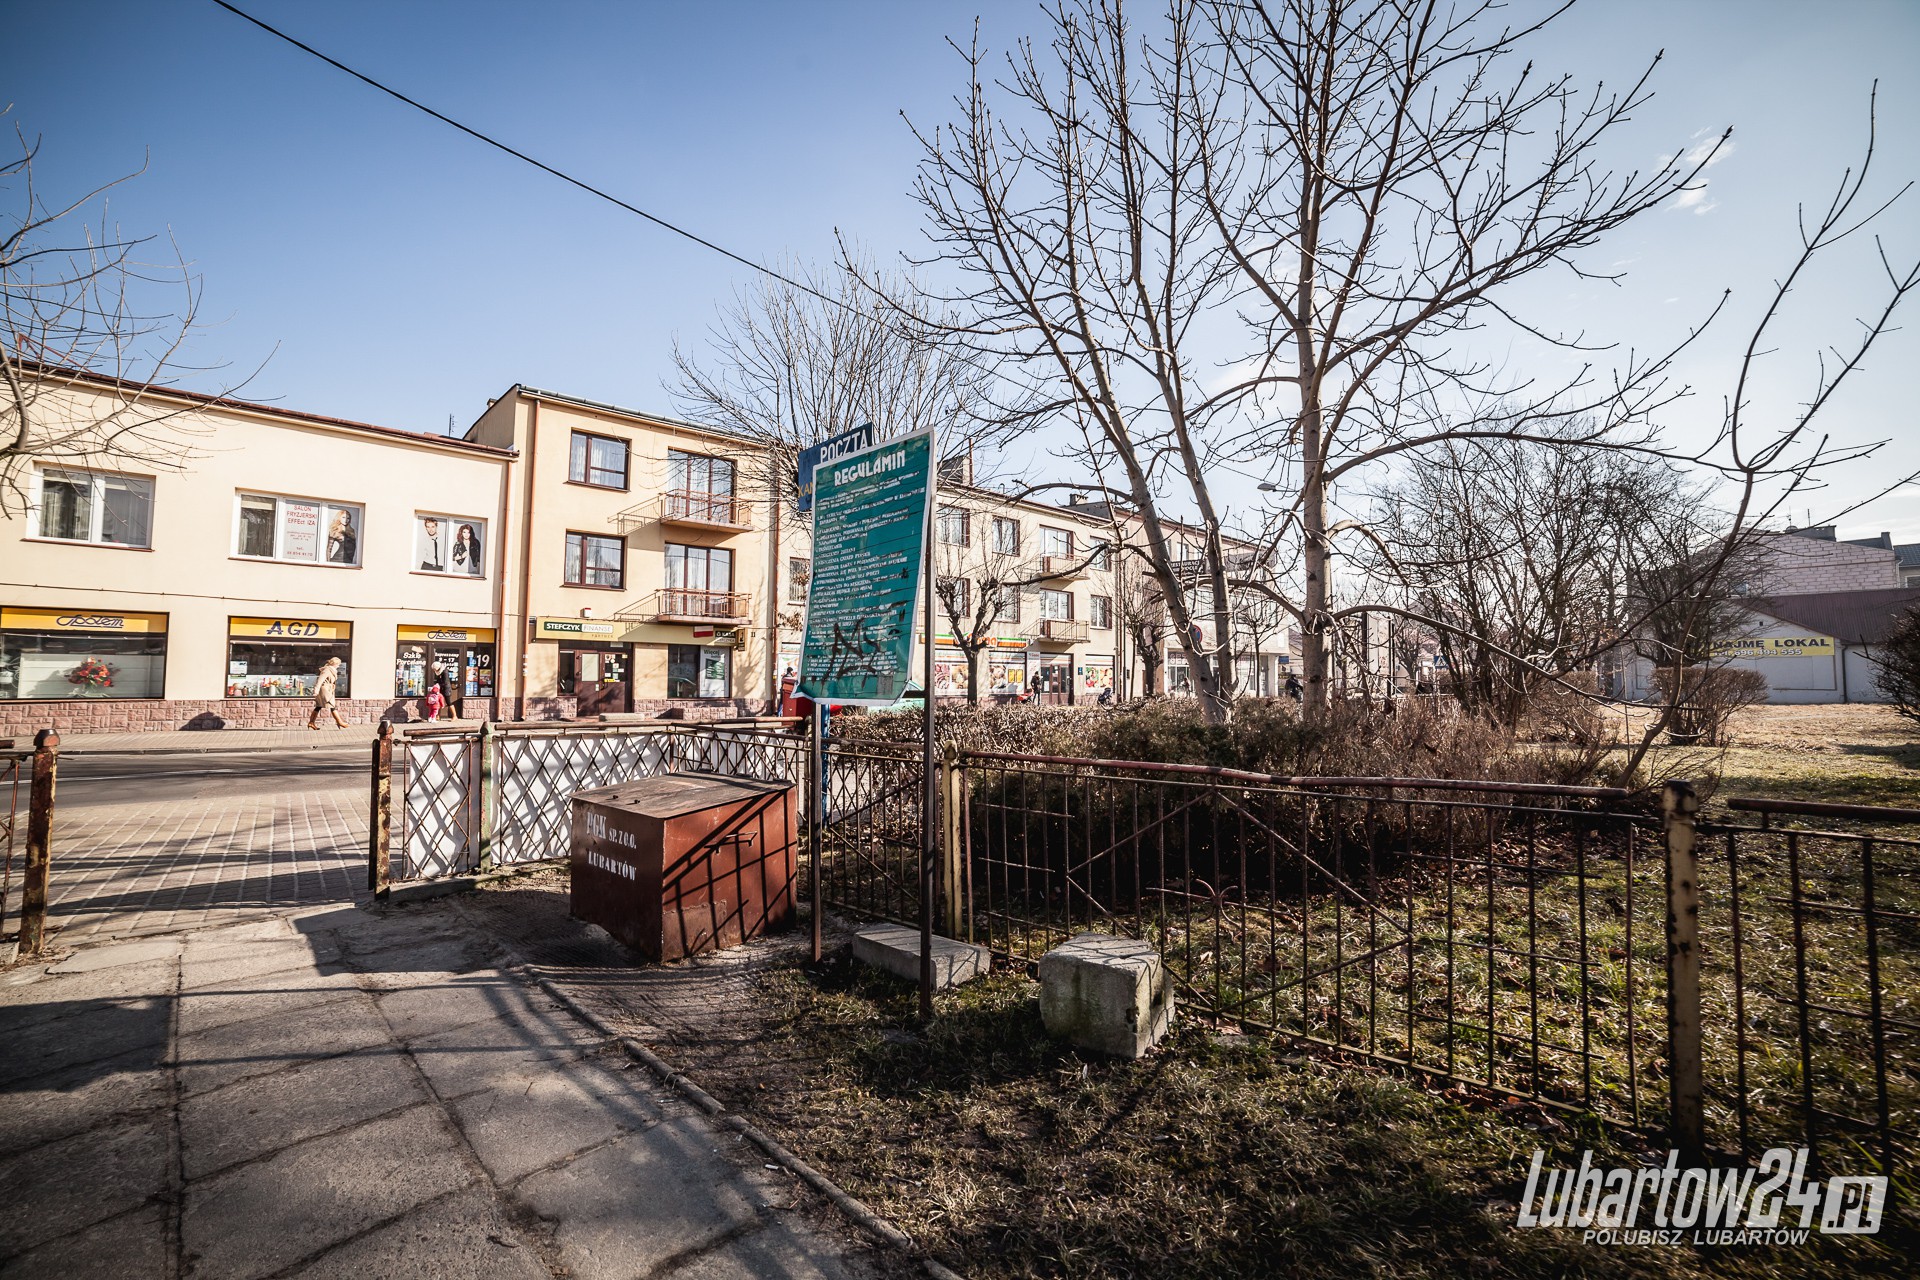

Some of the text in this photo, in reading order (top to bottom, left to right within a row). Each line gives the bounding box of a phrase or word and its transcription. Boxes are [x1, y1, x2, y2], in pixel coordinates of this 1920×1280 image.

[820, 429, 868, 463] POCZTA
[834, 450, 905, 487] REGULAMIN
[287, 511, 317, 519] FRYZJERSKI
[266, 621, 319, 636] AGD
[546, 623, 611, 632] STEFCZYK FINANSE
[1774, 639, 1829, 647] LOKAL
[477, 654, 490, 667] 19
[586, 812, 606, 840] PGK
[588, 851, 637, 881] LUBARTÓW
